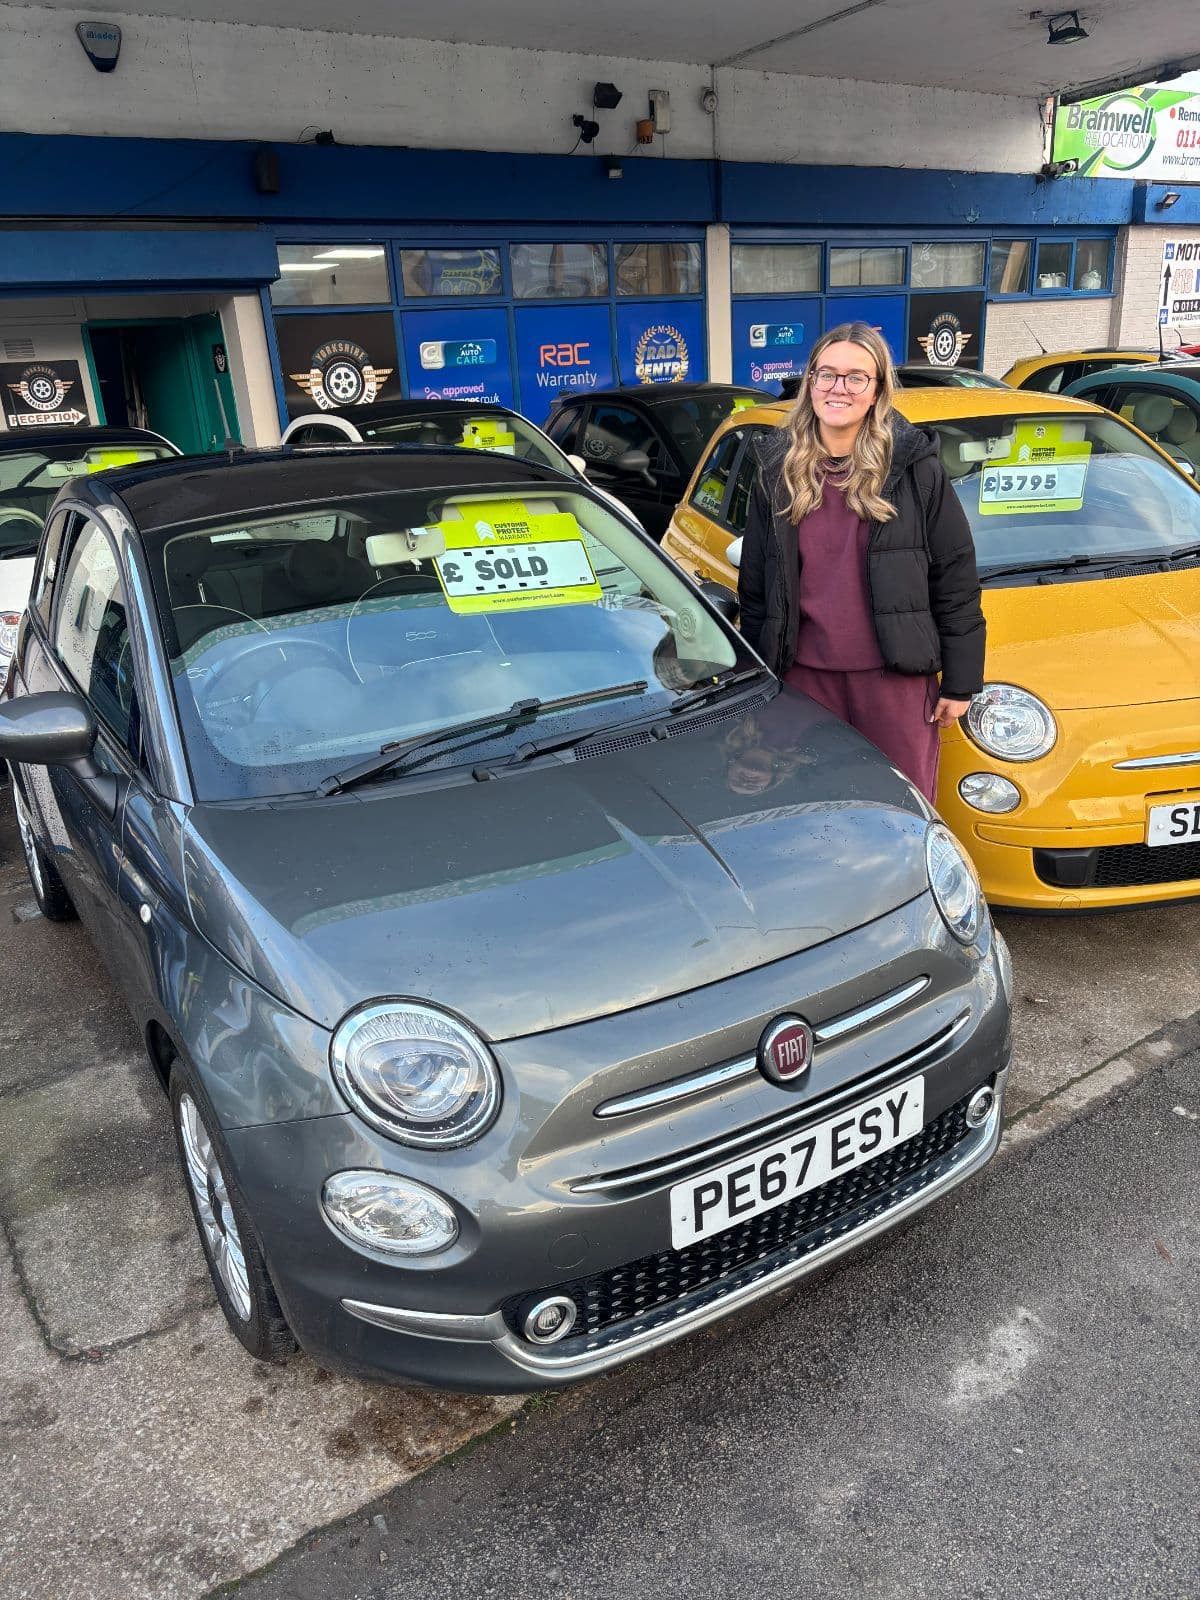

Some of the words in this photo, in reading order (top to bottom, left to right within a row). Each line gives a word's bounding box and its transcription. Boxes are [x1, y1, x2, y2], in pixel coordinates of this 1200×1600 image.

[1066, 104, 1154, 133] Bramwell
[1085, 131, 1148, 149] RELOCATION
[316, 343, 366, 361] YORKSHIRE
[456, 355, 485, 365] CARE
[461, 349, 479, 357] AUTO
[536, 371, 597, 388] Warranty
[443, 382, 485, 398] approved
[11, 412, 81, 425] RECEPTION
[494, 521, 528, 529] CUSTOMER
[442, 562, 464, 584] £
[474, 555, 549, 582] SOLD
[777, 1034, 804, 1068] FIAT
[693, 1136, 817, 1234] PE67
[831, 1091, 909, 1170] ESY
